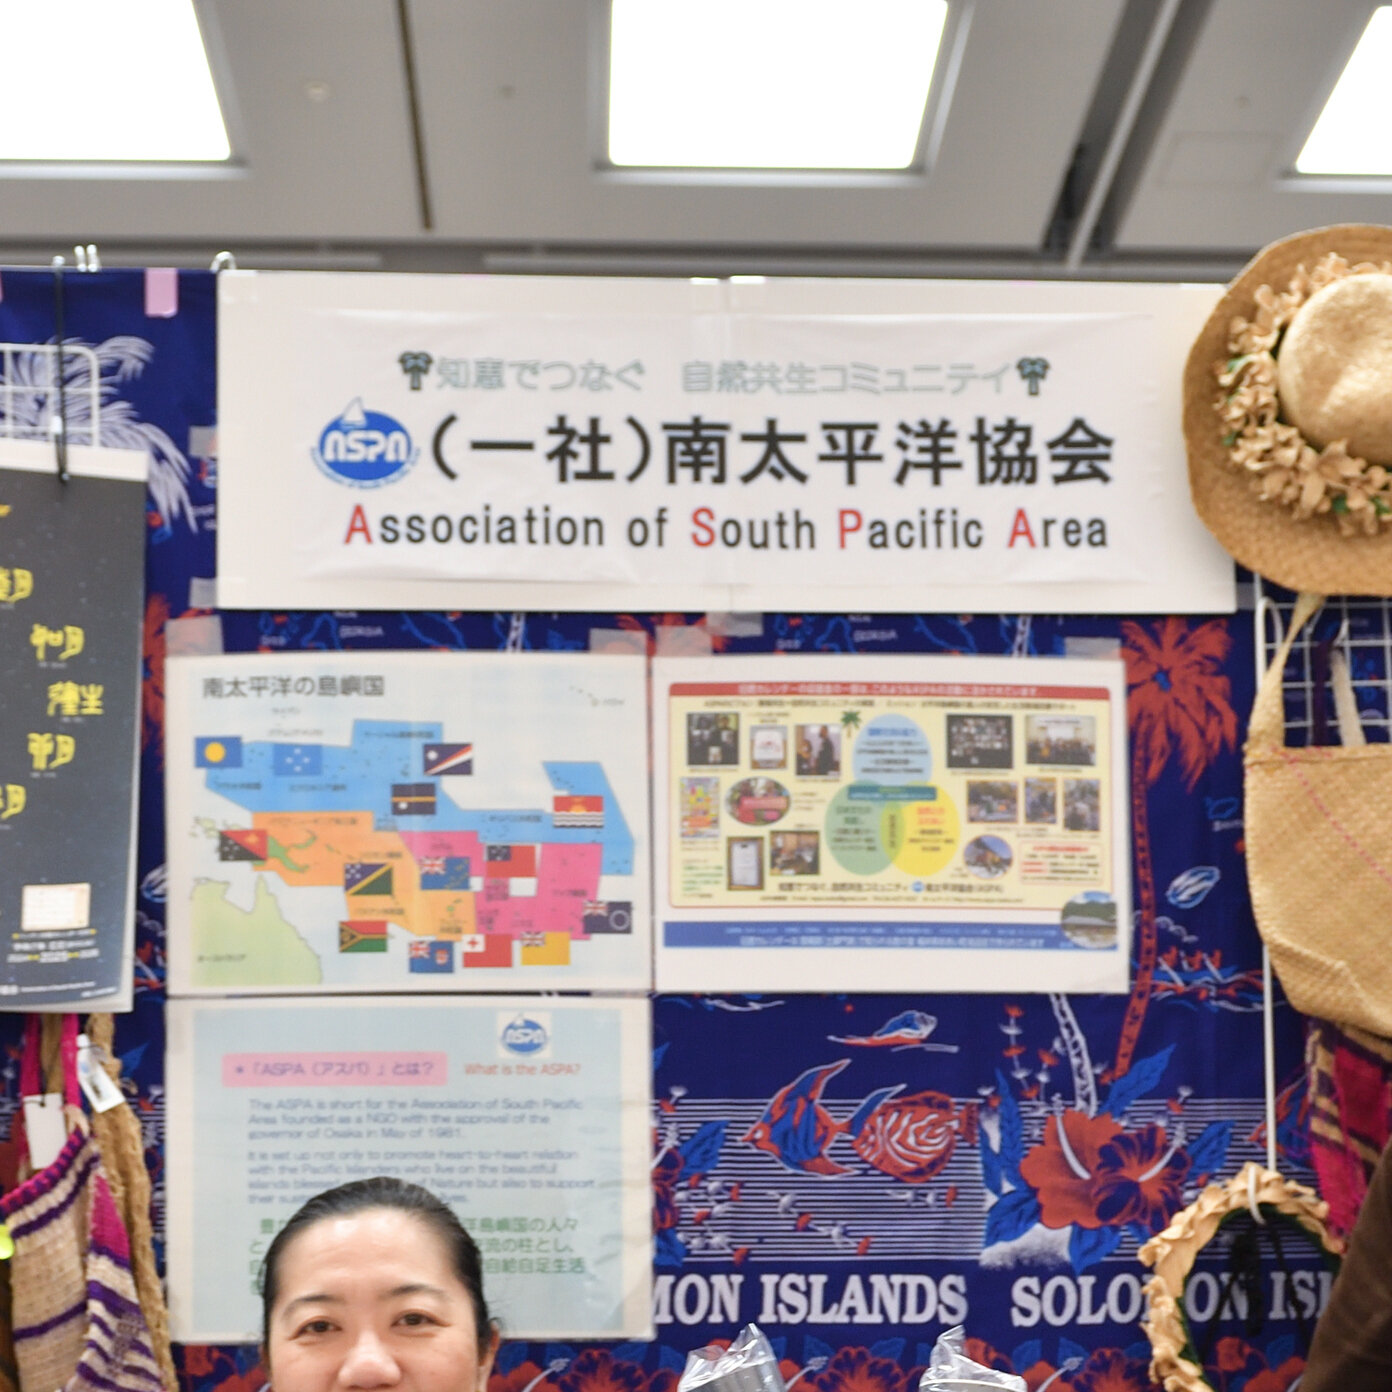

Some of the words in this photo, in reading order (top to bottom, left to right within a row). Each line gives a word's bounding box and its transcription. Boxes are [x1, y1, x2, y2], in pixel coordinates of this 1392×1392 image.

[436, 359, 646, 392] 知恵でつなぐ
[344, 504, 606, 548] Association
[627, 506, 670, 549] of
[691, 507, 816, 551] South
[838, 508, 984, 551] Pacific
[1008, 508, 1109, 550] Area
[202, 675, 385, 699] 南太平洋の島嶼国
[760, 1274, 969, 1327] ISLANDS
[1011, 1273, 1249, 1328] SOLOON
